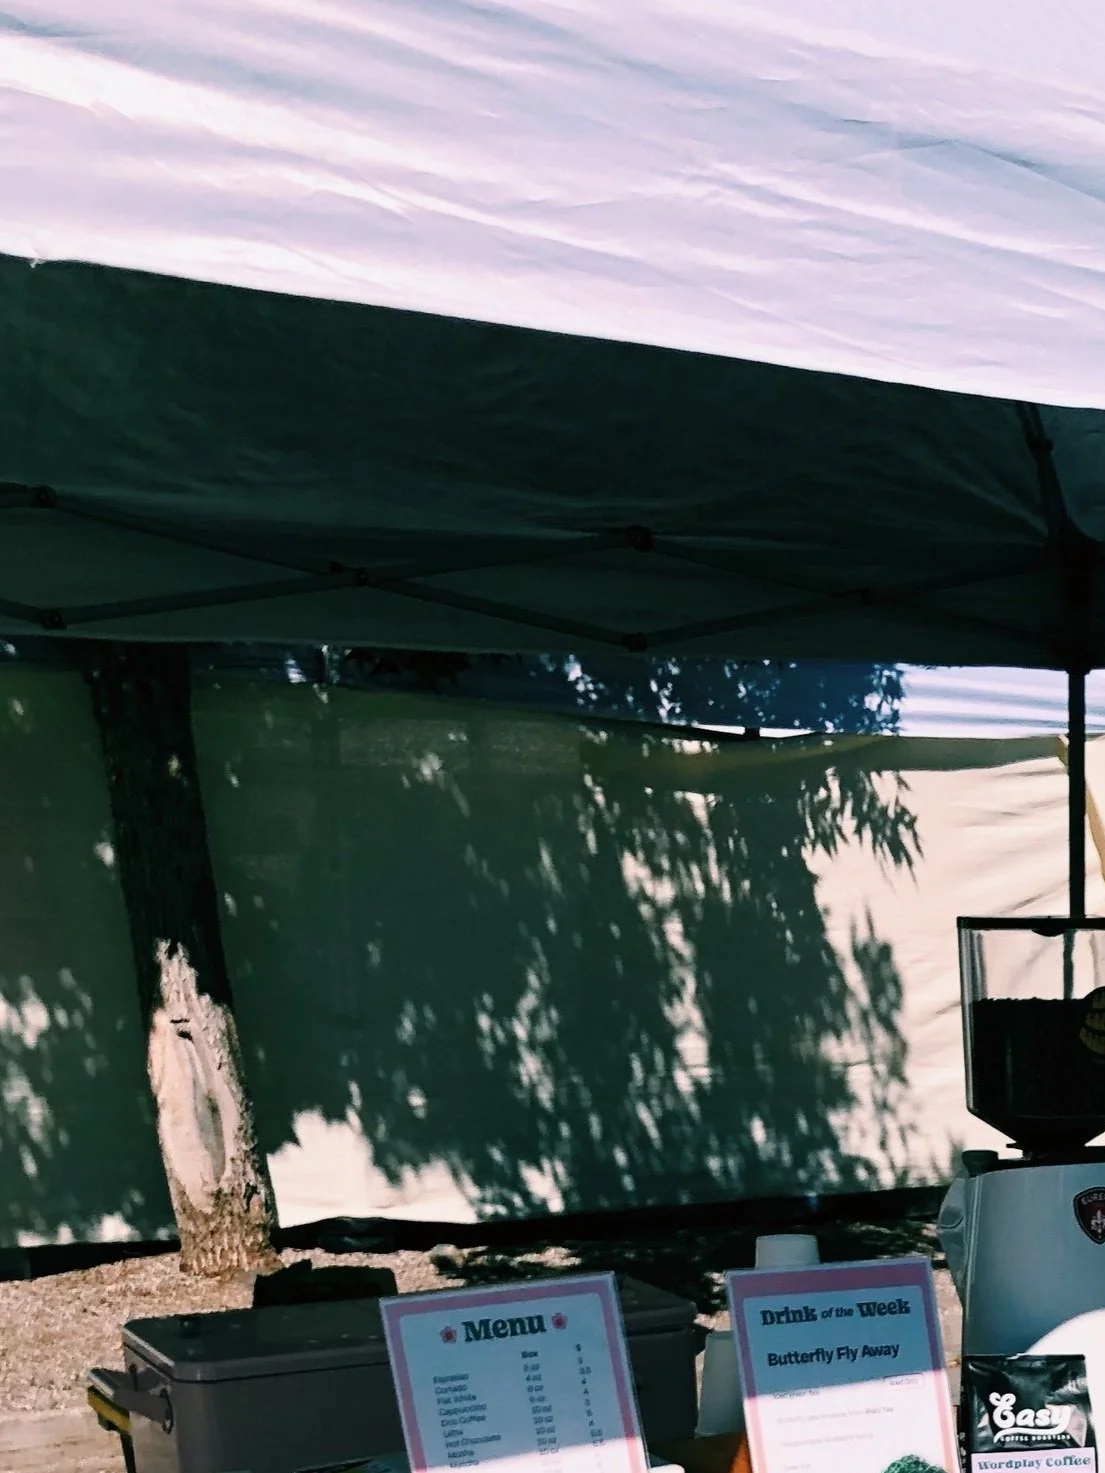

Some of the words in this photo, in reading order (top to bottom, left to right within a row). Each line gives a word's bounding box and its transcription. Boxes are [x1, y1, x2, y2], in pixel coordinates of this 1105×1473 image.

[760, 1304, 818, 1326] Drink
[821, 1307, 834, 1319] of
[834, 1306, 854, 1318] the
[857, 1298, 911, 1317] Week
[462, 1314, 547, 1342] Menu
[767, 1346, 834, 1367] Butterfly
[836, 1345, 858, 1363] Fly
[861, 1343, 901, 1360] Away
[988, 1392, 1072, 1443] Easy
[1000, 1435, 1029, 1443] COFFEE
[1031, 1434, 1071, 1442] ROASTERS
[977, 1457, 1042, 1471] Wordplay
[1045, 1454, 1091, 1467] Coffee
